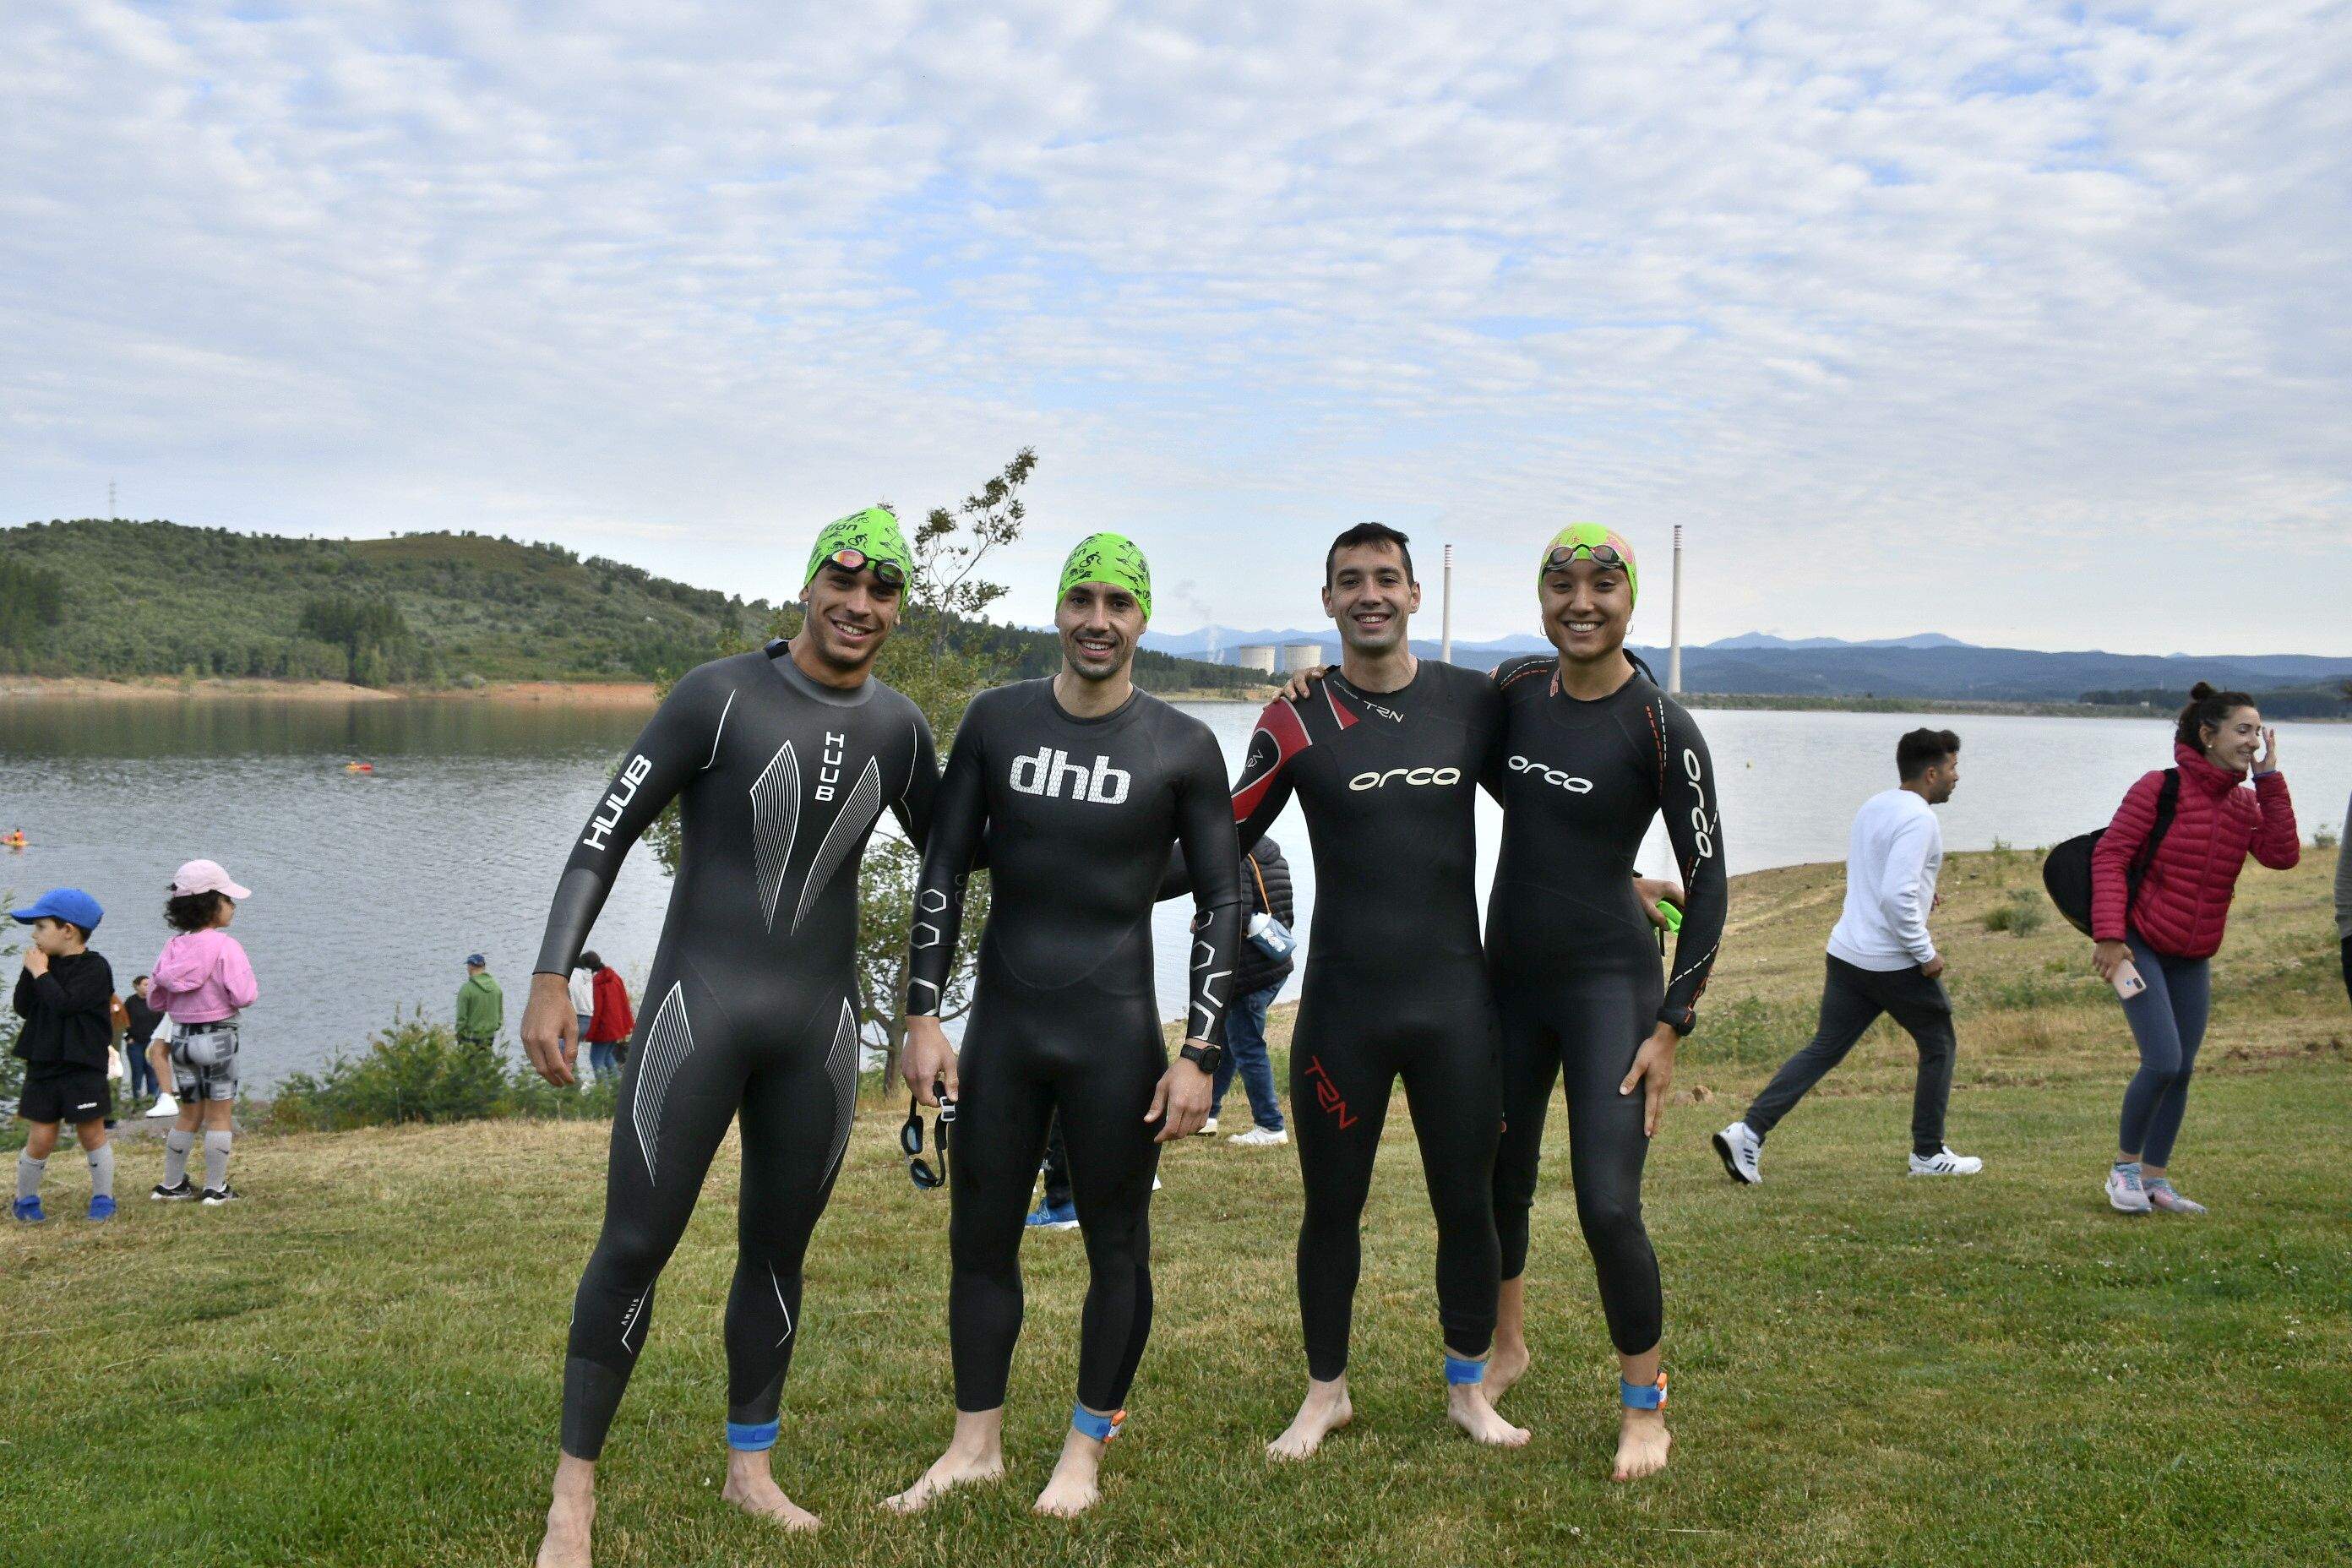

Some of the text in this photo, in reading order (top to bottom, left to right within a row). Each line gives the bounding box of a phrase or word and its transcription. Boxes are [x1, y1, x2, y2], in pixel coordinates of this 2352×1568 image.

[814, 731, 846, 802] HUUB
[1009, 745, 1132, 805] dhb
[1348, 766, 1462, 792] orca
[1508, 755, 1594, 794] orca
[583, 752, 653, 852] HUUB
[1683, 748, 1713, 858] orca
